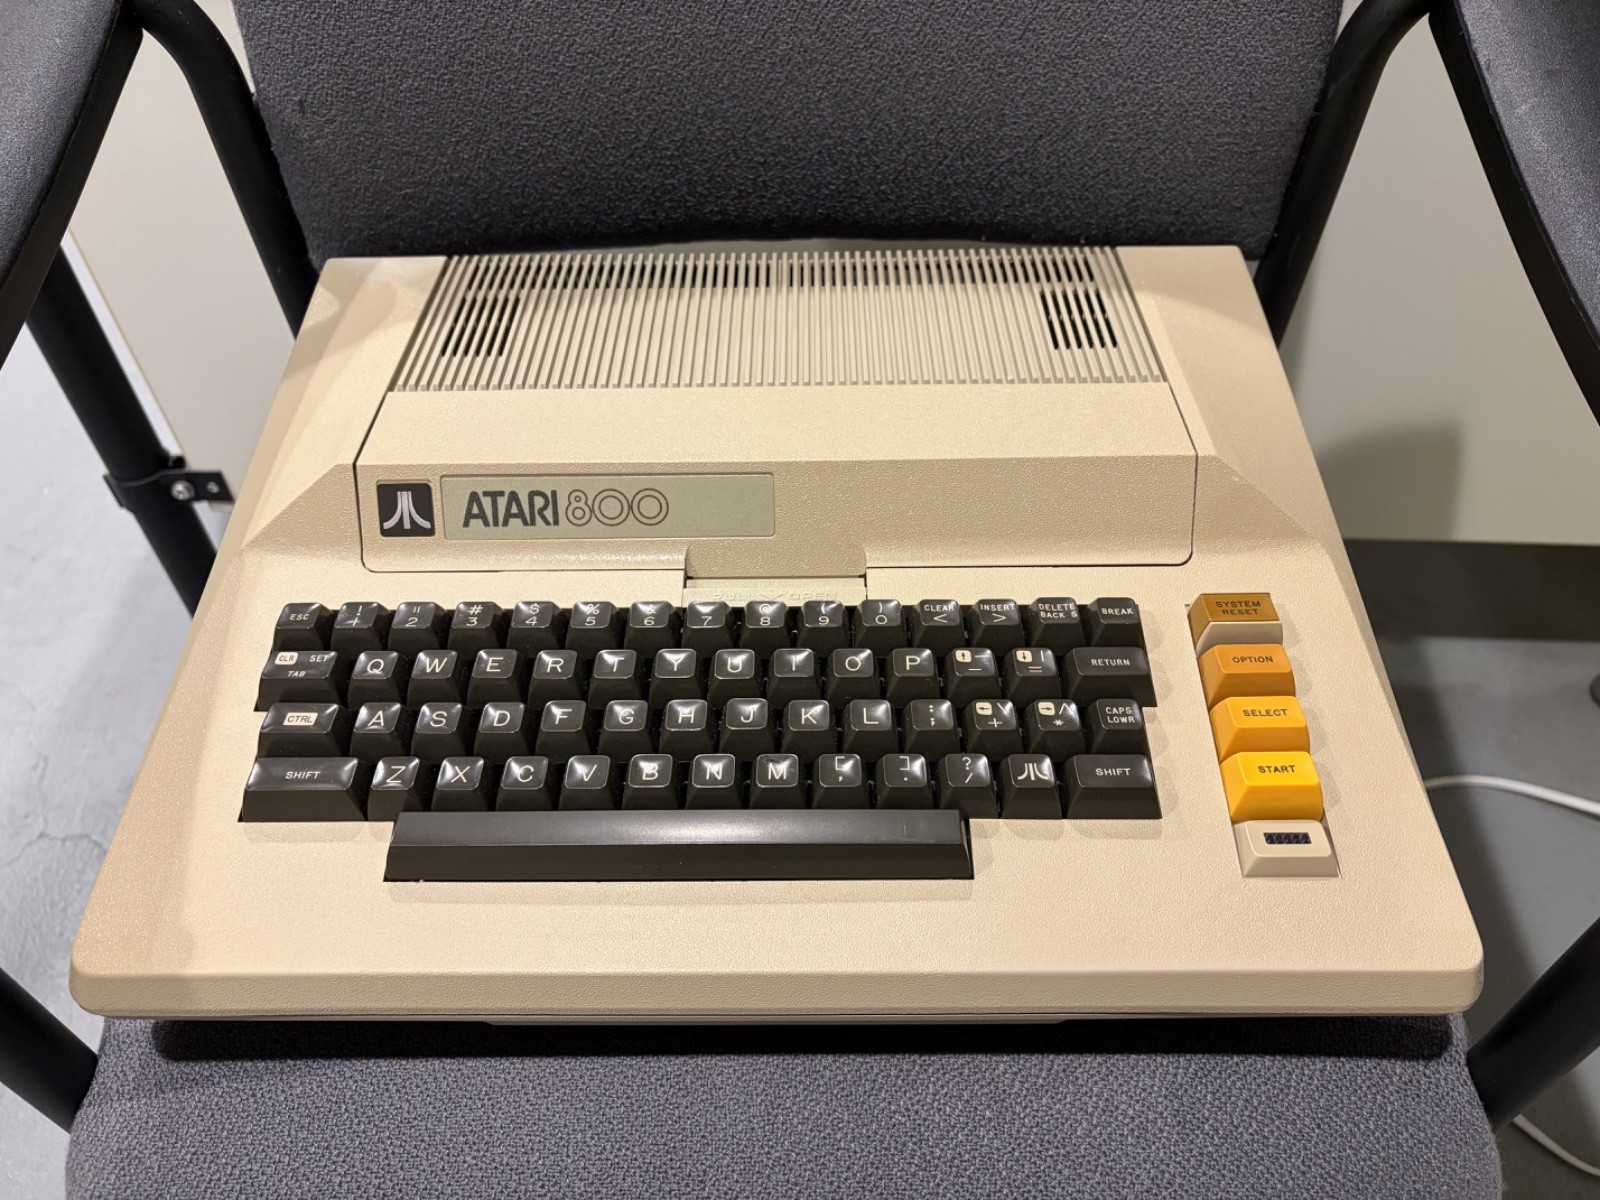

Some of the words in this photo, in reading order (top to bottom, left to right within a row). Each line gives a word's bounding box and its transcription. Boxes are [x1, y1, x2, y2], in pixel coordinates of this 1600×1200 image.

[462, 489, 560, 528] ATARI
[565, 487, 670, 527] 800
[468, 604, 484, 615] #
[529, 603, 540, 615] $
[586, 603, 600, 615] %
[924, 604, 955, 612] CLEAR
[980, 603, 1016, 612] INSERT
[1038, 603, 1076, 612] DELETE
[1216, 600, 1261, 608] SYSTEM
[1040, 611, 1066, 619] BACK
[1101, 607, 1134, 615] BREAK
[1221, 608, 1259, 616] RESET
[289, 613, 310, 621] ESC
[405, 617, 419, 627] 2
[466, 616, 478, 627] 3
[525, 616, 538, 626] 4
[584, 616, 596, 626] 5
[643, 616, 655, 626] 6
[701, 616, 713, 626] 7
[760, 616, 771, 626] 8
[818, 616, 830, 625] 9
[309, 654, 329, 662] SET
[668, 655, 686, 672] Y
[905, 655, 920, 671] P
[1091, 658, 1130, 666] RETURN
[366, 658, 385, 675] Q
[425, 657, 448, 673] W
[486, 657, 504, 672] E
[546, 658, 564, 673] R
[610, 657, 625, 673] T
[727, 657, 743, 673] U
[287, 670, 307, 678] TAB
[678, 706, 695, 724] H
[740, 706, 755, 723] J
[801, 707, 818, 725] K
[863, 707, 879, 724] L
[1105, 706, 1132, 715] CAPS
[1242, 708, 1288, 716] SELECT
[287, 714, 313, 724] CTRL
[367, 710, 385, 727] A
[430, 711, 447, 727] S
[493, 710, 511, 727] D
[555, 708, 573, 725] F
[619, 708, 635, 725] G
[1107, 716, 1136, 724] LOWR
[987, 717, 1003, 728] +
[962, 756, 971, 770] ?
[386, 765, 406, 783] Z
[450, 765, 471, 783] X
[517, 765, 534, 782] C
[581, 764, 598, 782] V
[642, 763, 659, 780] B
[706, 762, 723, 780] N
[768, 762, 787, 780] M
[1095, 768, 1131, 776] SHIFT
[1258, 765, 1296, 773] START
[285, 771, 321, 780] SHIFT
